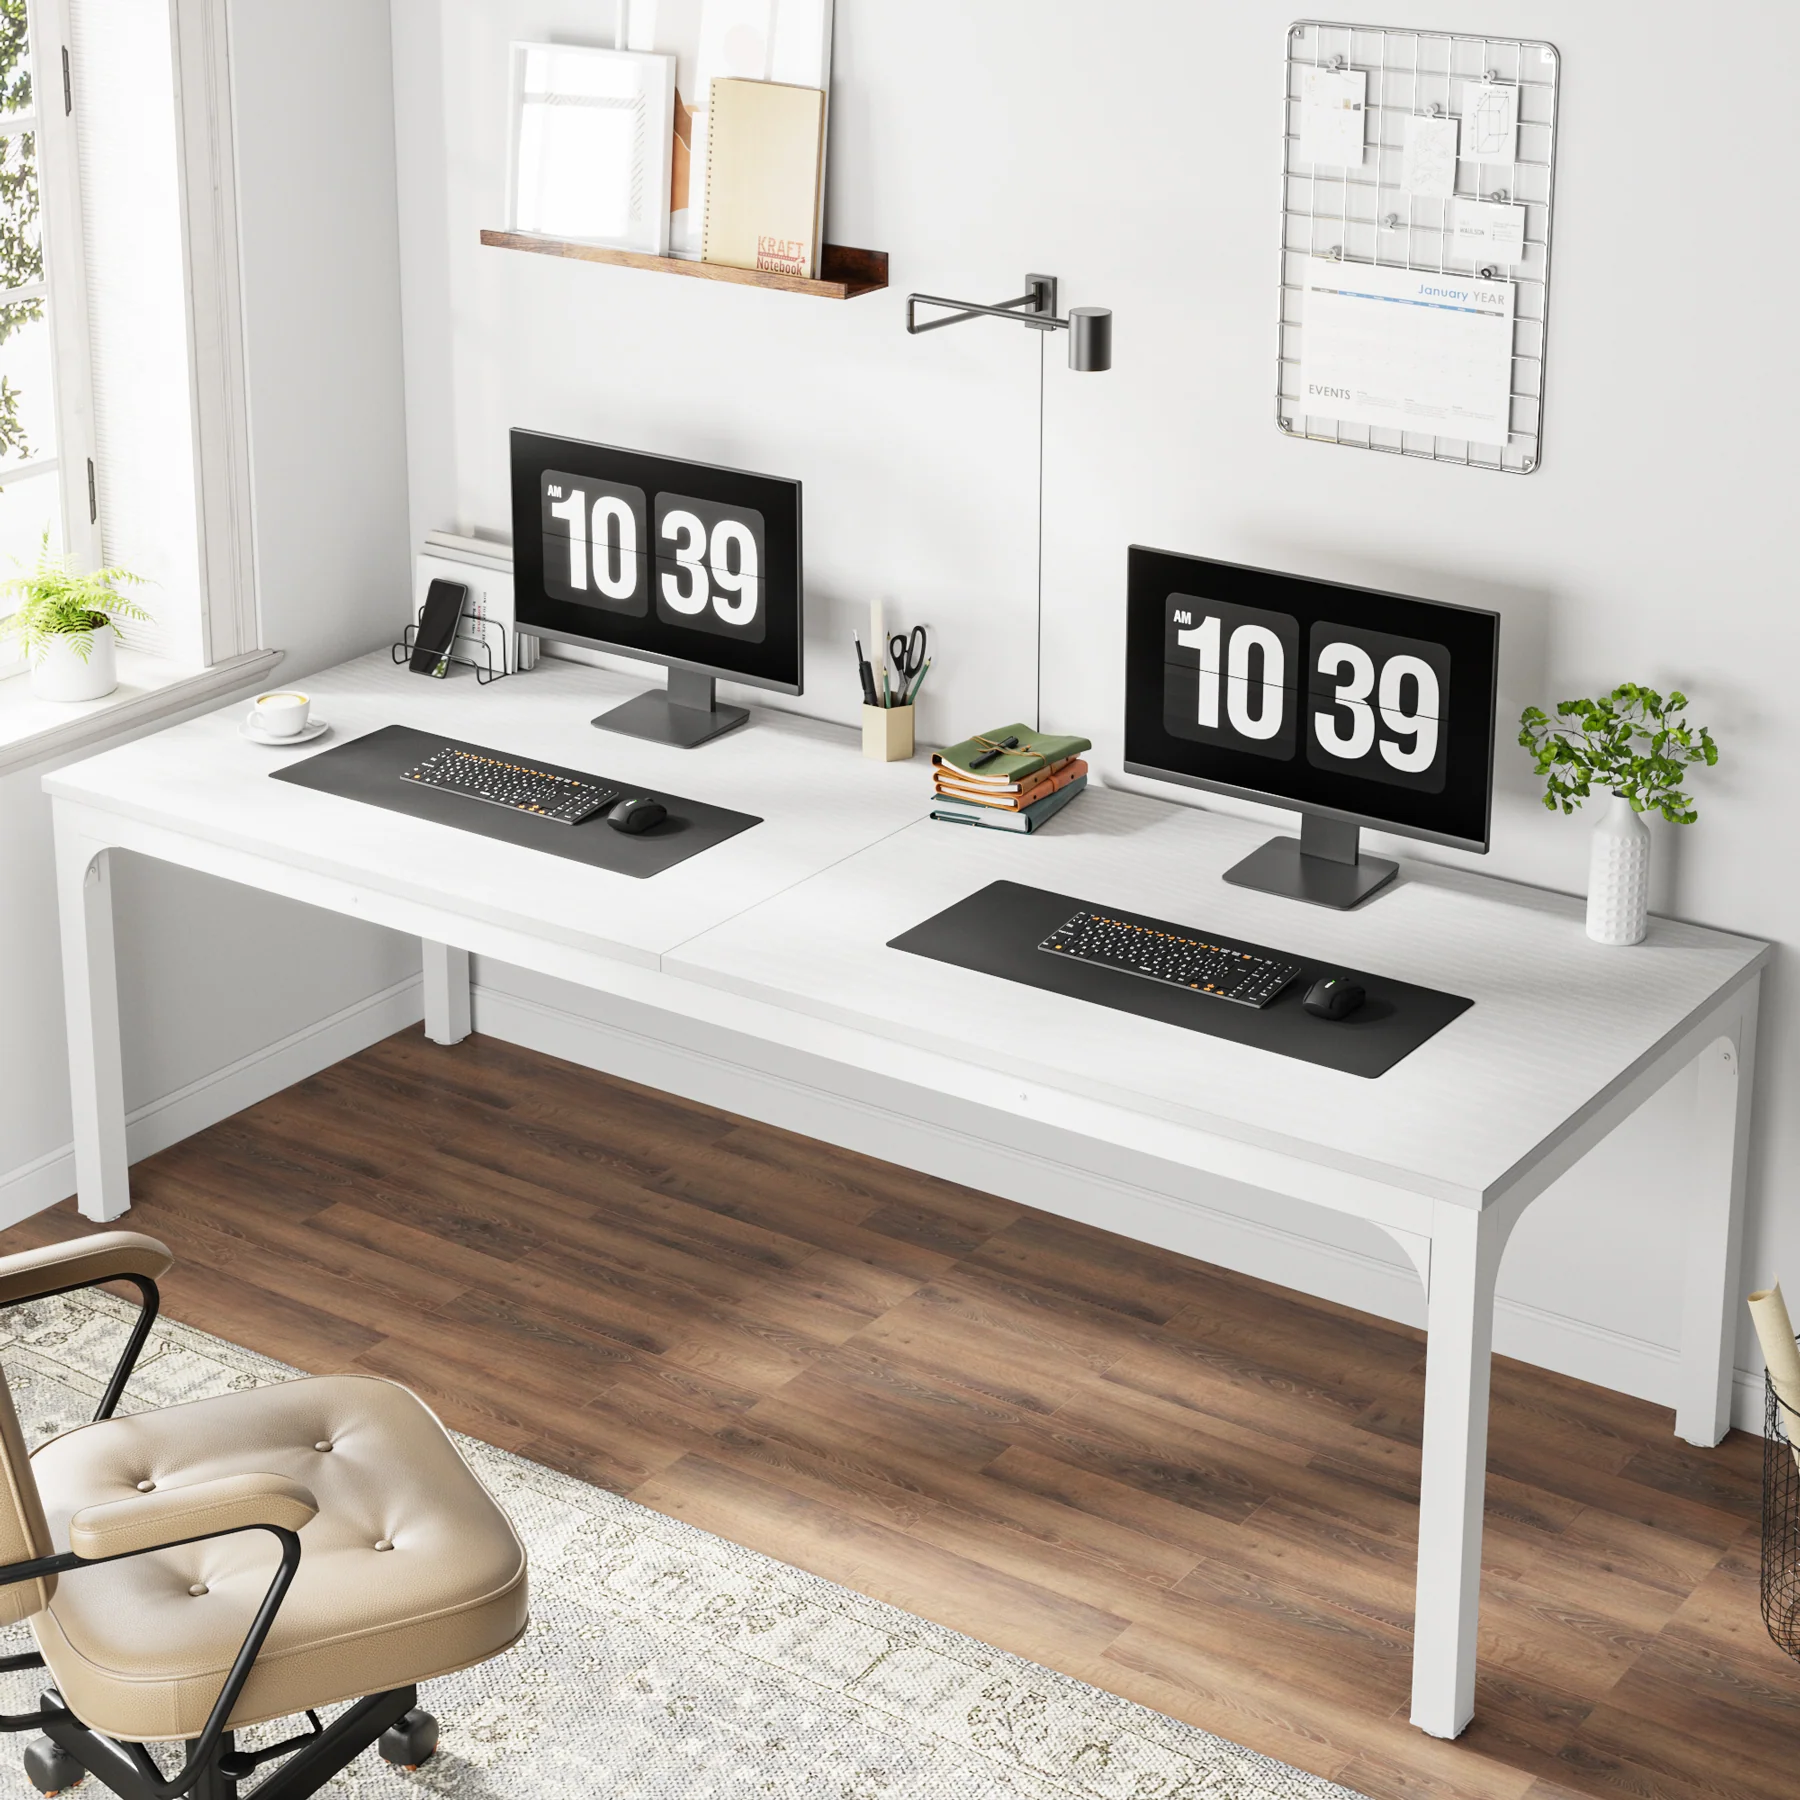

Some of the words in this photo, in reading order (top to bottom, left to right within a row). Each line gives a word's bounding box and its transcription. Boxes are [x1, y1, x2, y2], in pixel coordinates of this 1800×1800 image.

[757, 235, 804, 258] KRAFT
[756, 256, 803, 276] Notebook
[1418, 284, 1468, 302] January
[1473, 291, 1505, 305] YEAR
[1309, 384, 1351, 400] EVENTS
[547, 484, 562, 498] AM
[551, 489, 637, 600] 10
[661, 510, 758, 626] 39
[1173, 609, 1192, 625] AM
[1178, 615, 1285, 741] 10
[1314, 641, 1440, 774] 39
